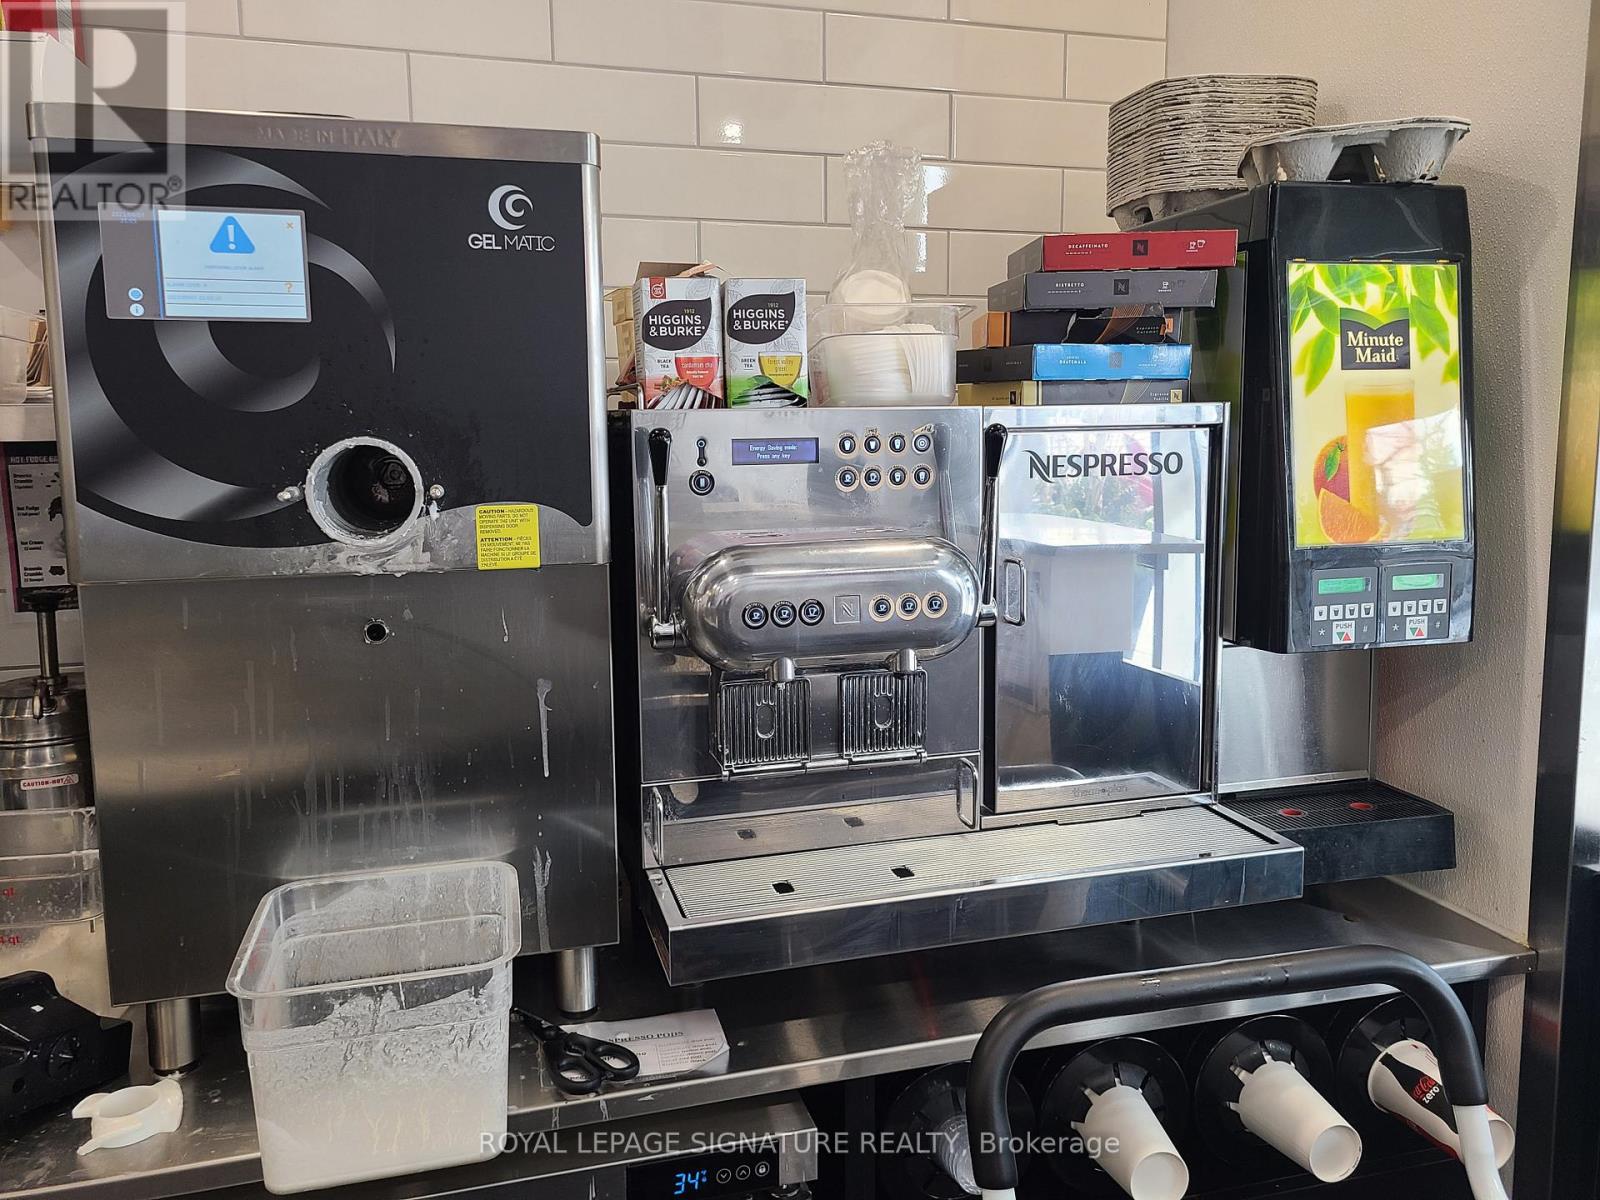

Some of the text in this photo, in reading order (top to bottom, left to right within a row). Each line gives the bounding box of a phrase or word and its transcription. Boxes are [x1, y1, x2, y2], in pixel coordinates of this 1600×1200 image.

[342, 127, 401, 148] ITALY
[468, 233, 555, 251] GEL MATIC
[649, 314, 702, 325] HIGGINS
[733, 309, 786, 319] HIGGINS
[1346, 329, 1404, 348] Minute
[1354, 346, 1397, 363] Maid
[1024, 449, 1183, 483] NESPRESSO
[1422, 1084, 1440, 1104] zero
